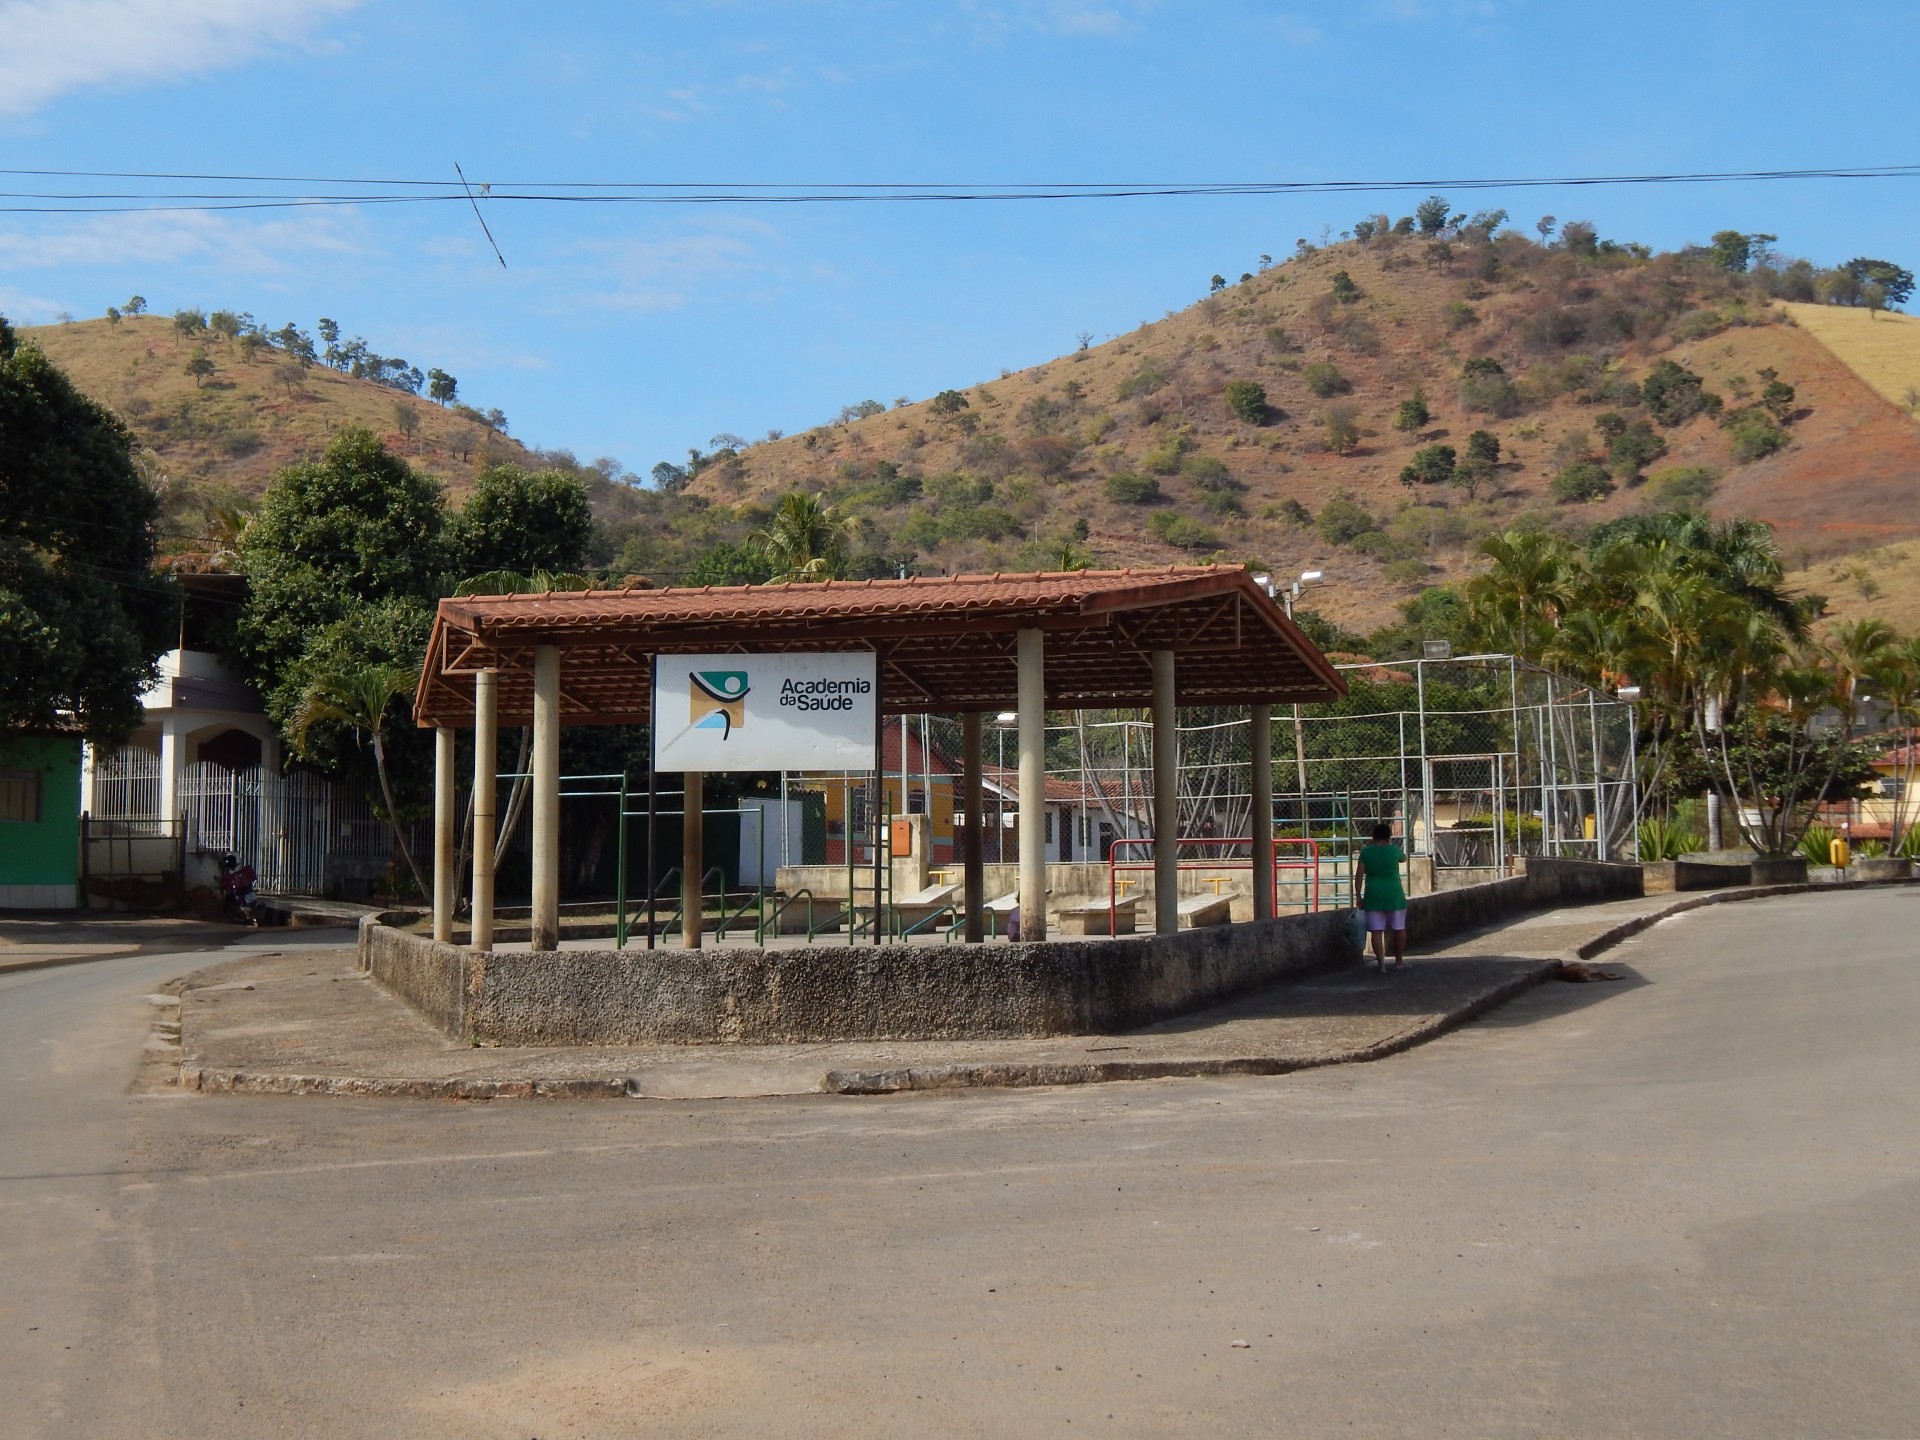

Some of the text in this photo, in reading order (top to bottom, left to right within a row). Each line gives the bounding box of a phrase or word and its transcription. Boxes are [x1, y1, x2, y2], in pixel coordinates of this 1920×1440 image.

[780, 678, 871, 694] Academia
[780, 694, 853, 711] da Saúde
